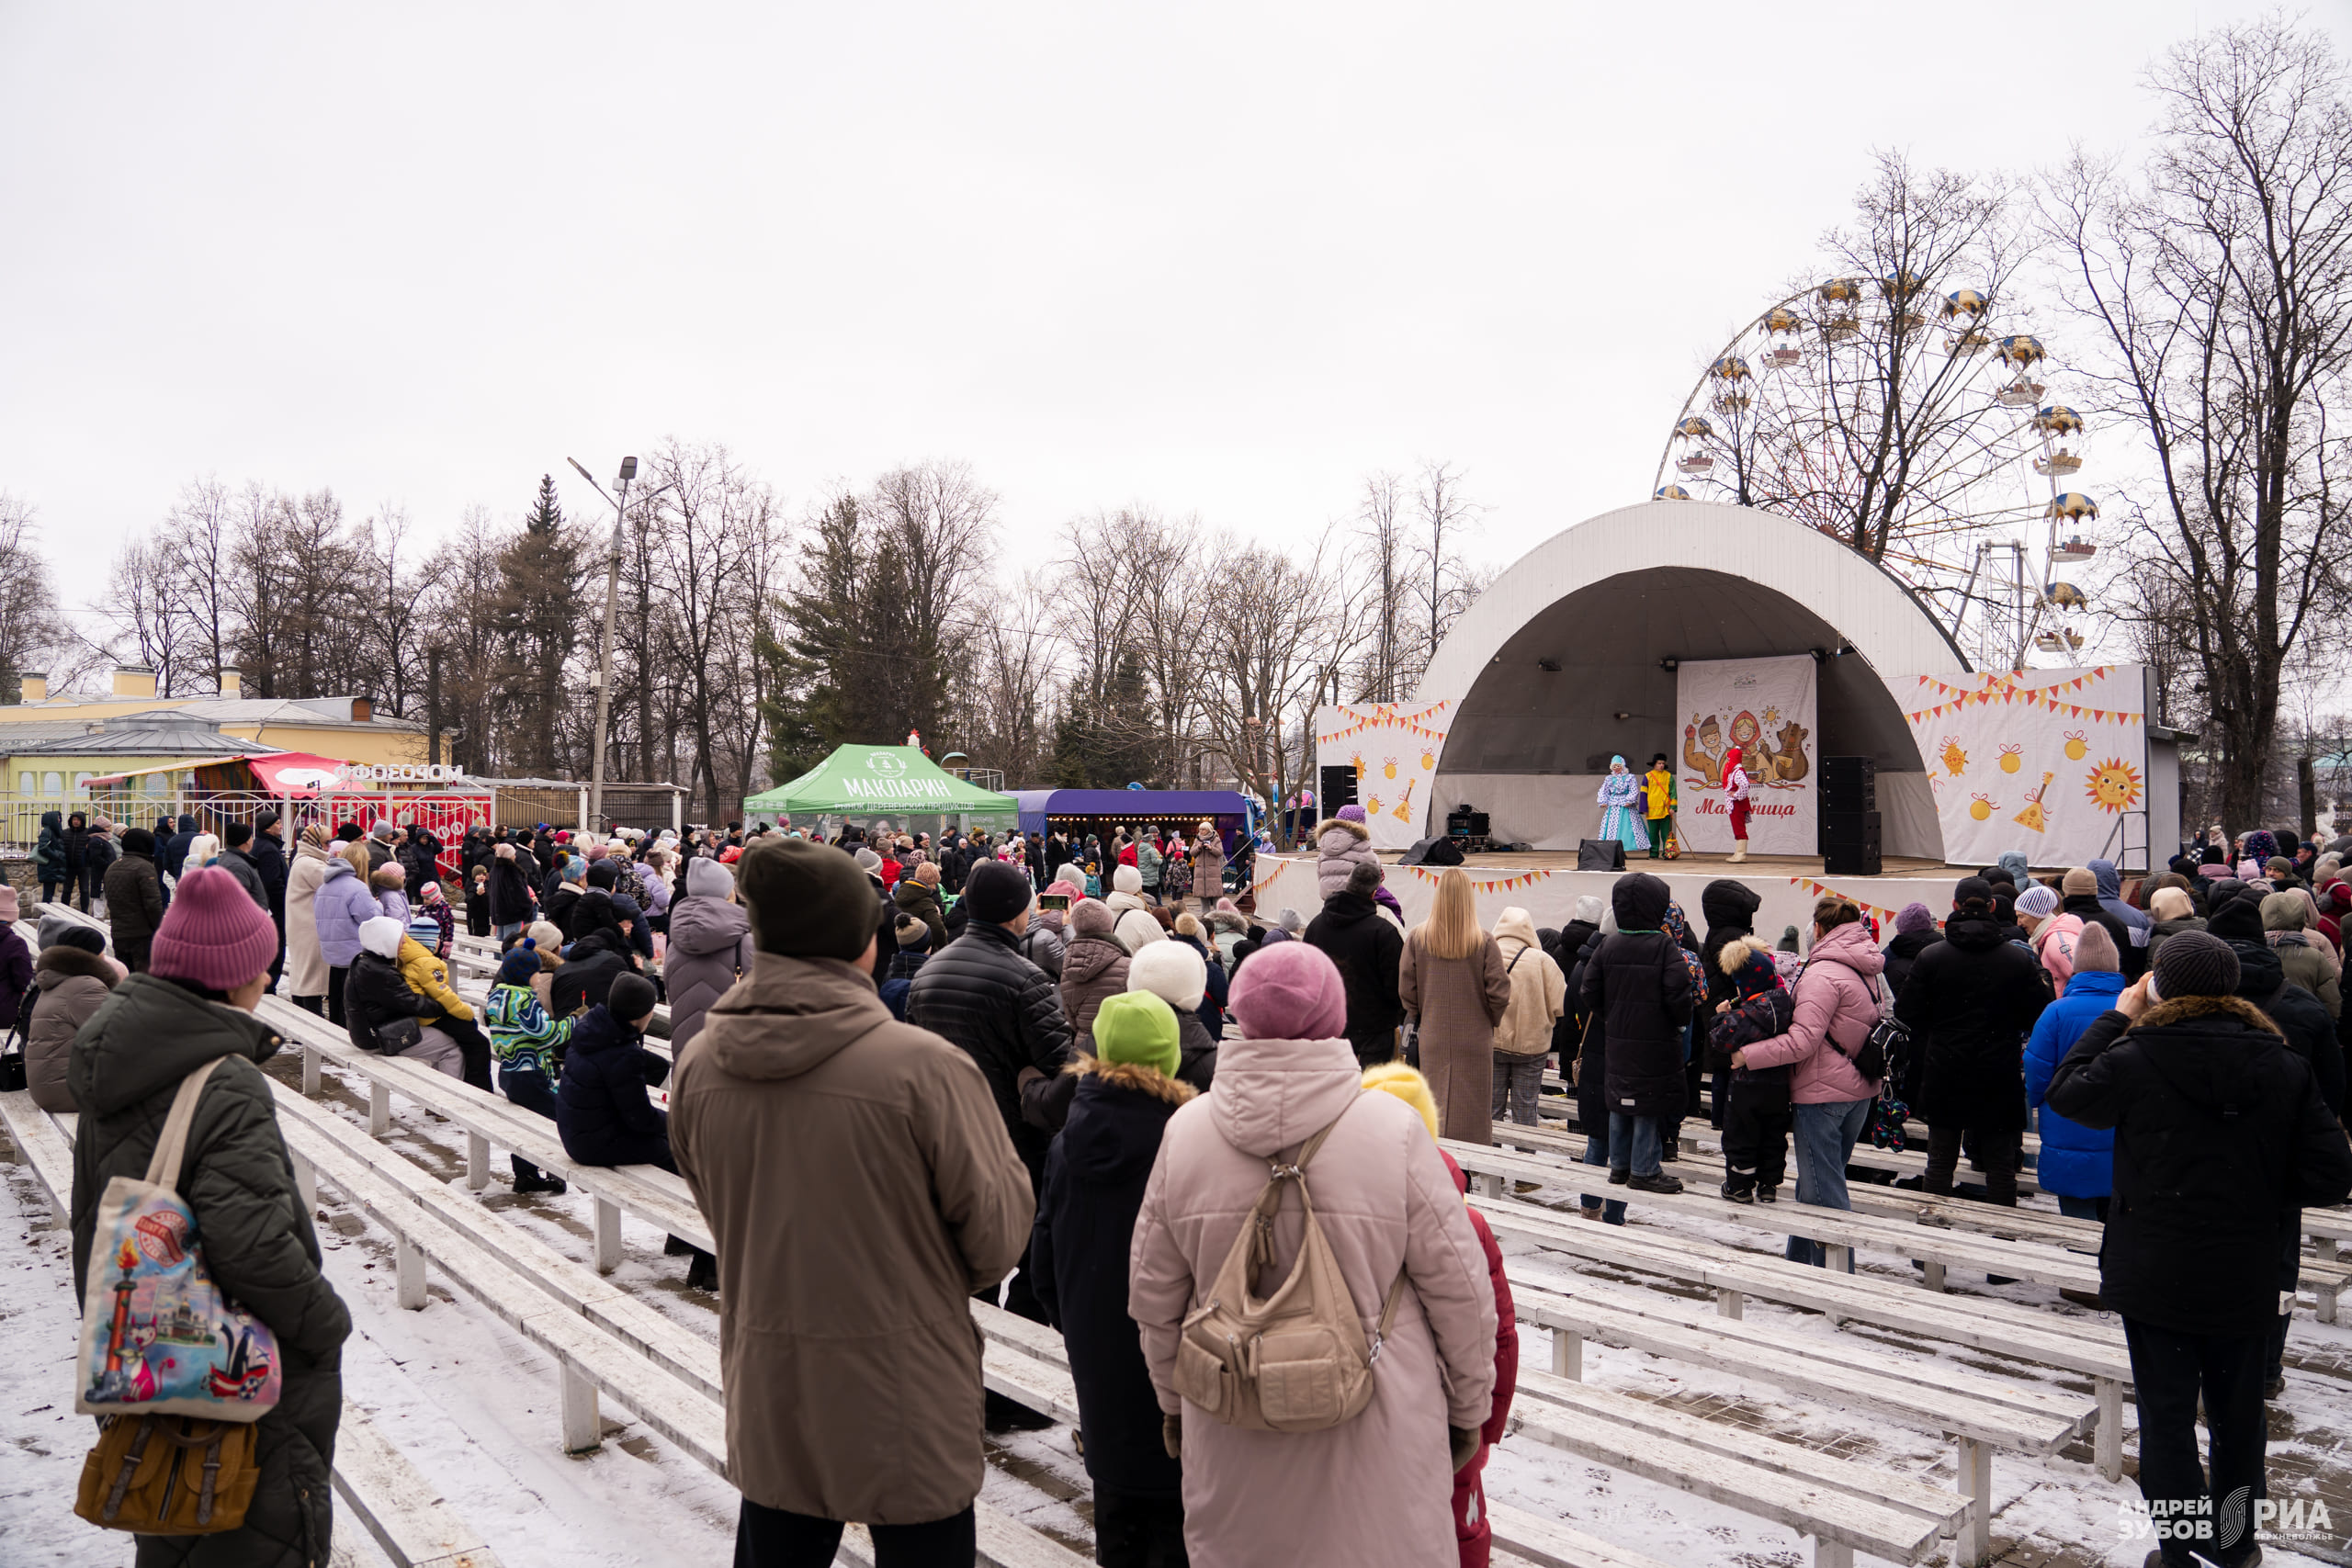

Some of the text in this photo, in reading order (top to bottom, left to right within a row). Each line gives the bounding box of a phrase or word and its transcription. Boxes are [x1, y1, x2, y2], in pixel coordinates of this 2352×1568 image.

[842, 778, 952, 797] МАКЛАРИН
[834, 801, 975, 811] РЫНОК ДЕРЕВЕНСКИХ ПРОДУКТОВ
[1695, 798, 1796, 819] Маница
